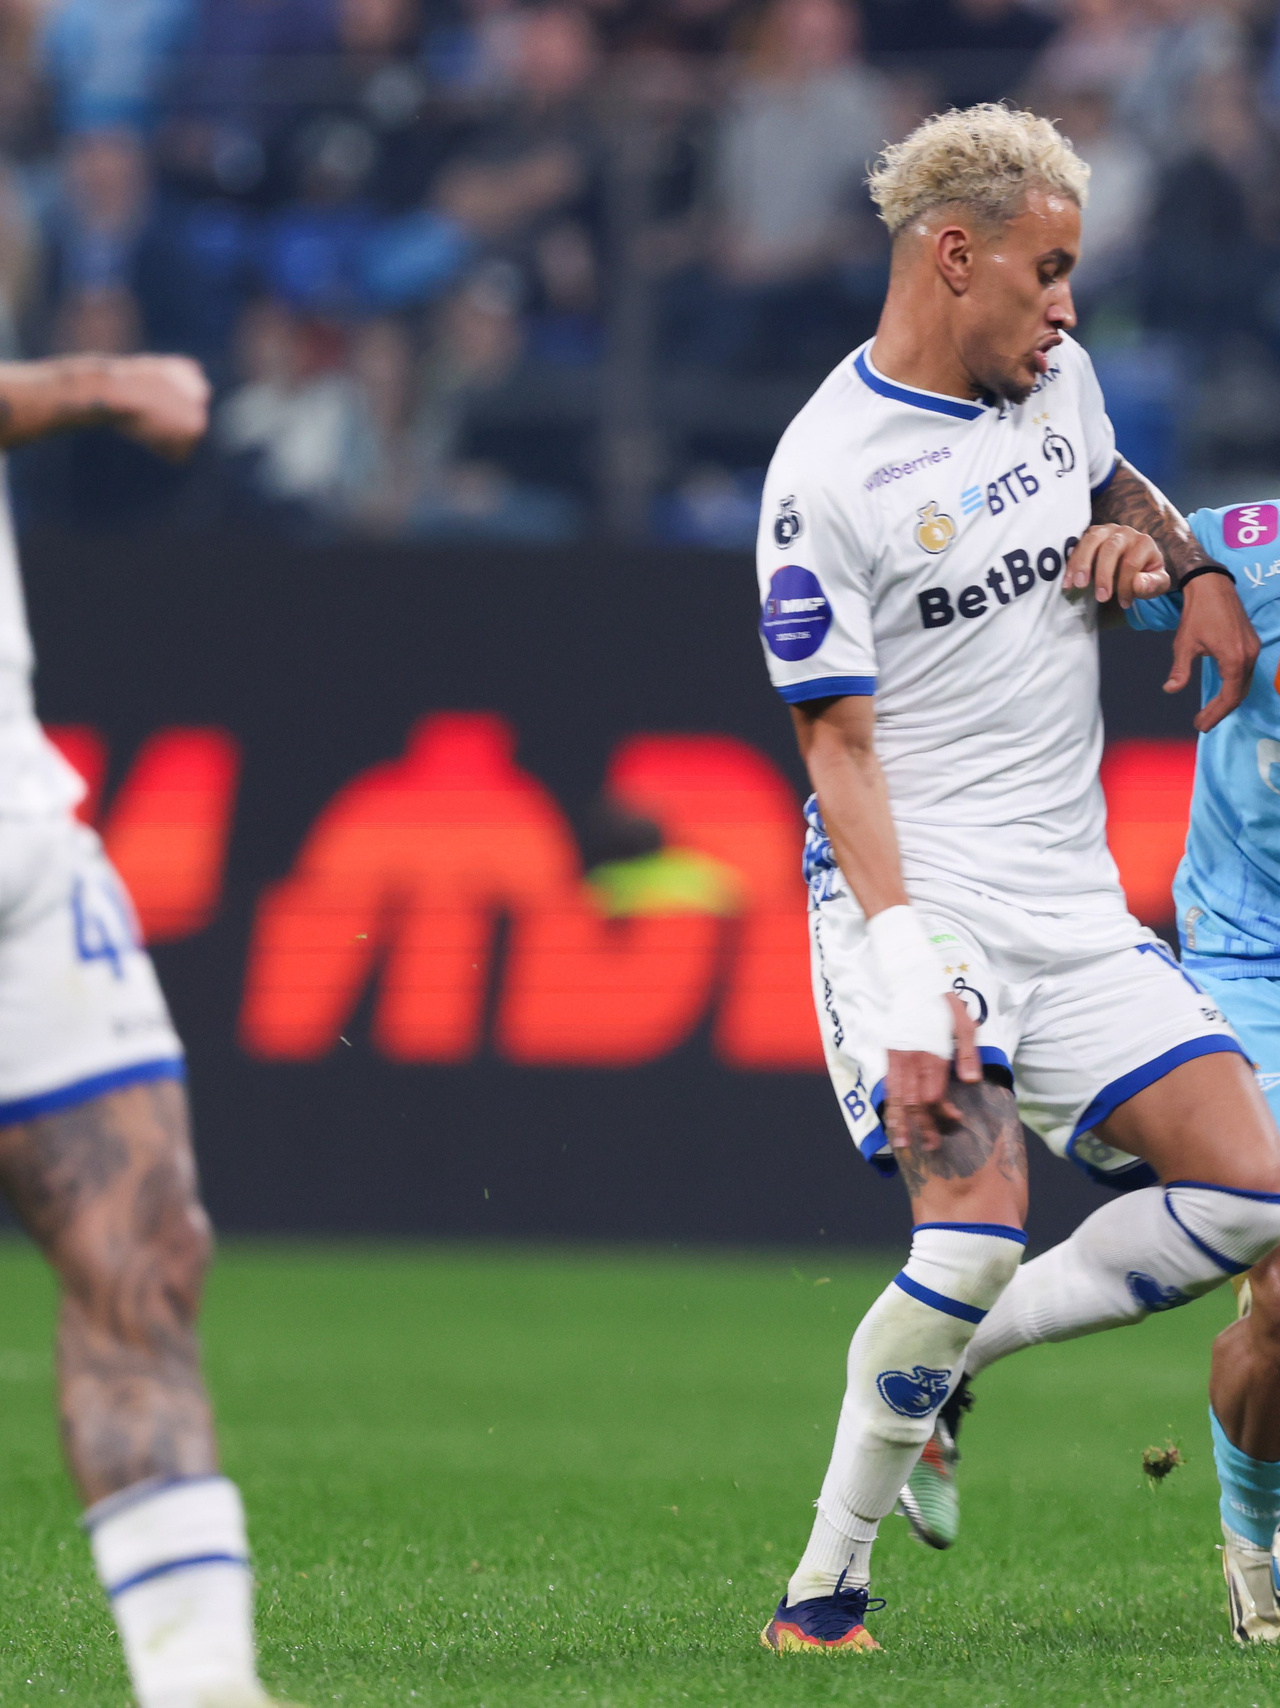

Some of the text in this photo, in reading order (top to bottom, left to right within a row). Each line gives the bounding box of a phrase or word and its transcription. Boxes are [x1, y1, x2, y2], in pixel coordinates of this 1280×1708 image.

[864, 446, 952, 492] wildberries
[986, 462, 1041, 516] ВТБ
[1237, 506, 1268, 545] wb
[917, 536, 1081, 630] BetBo
